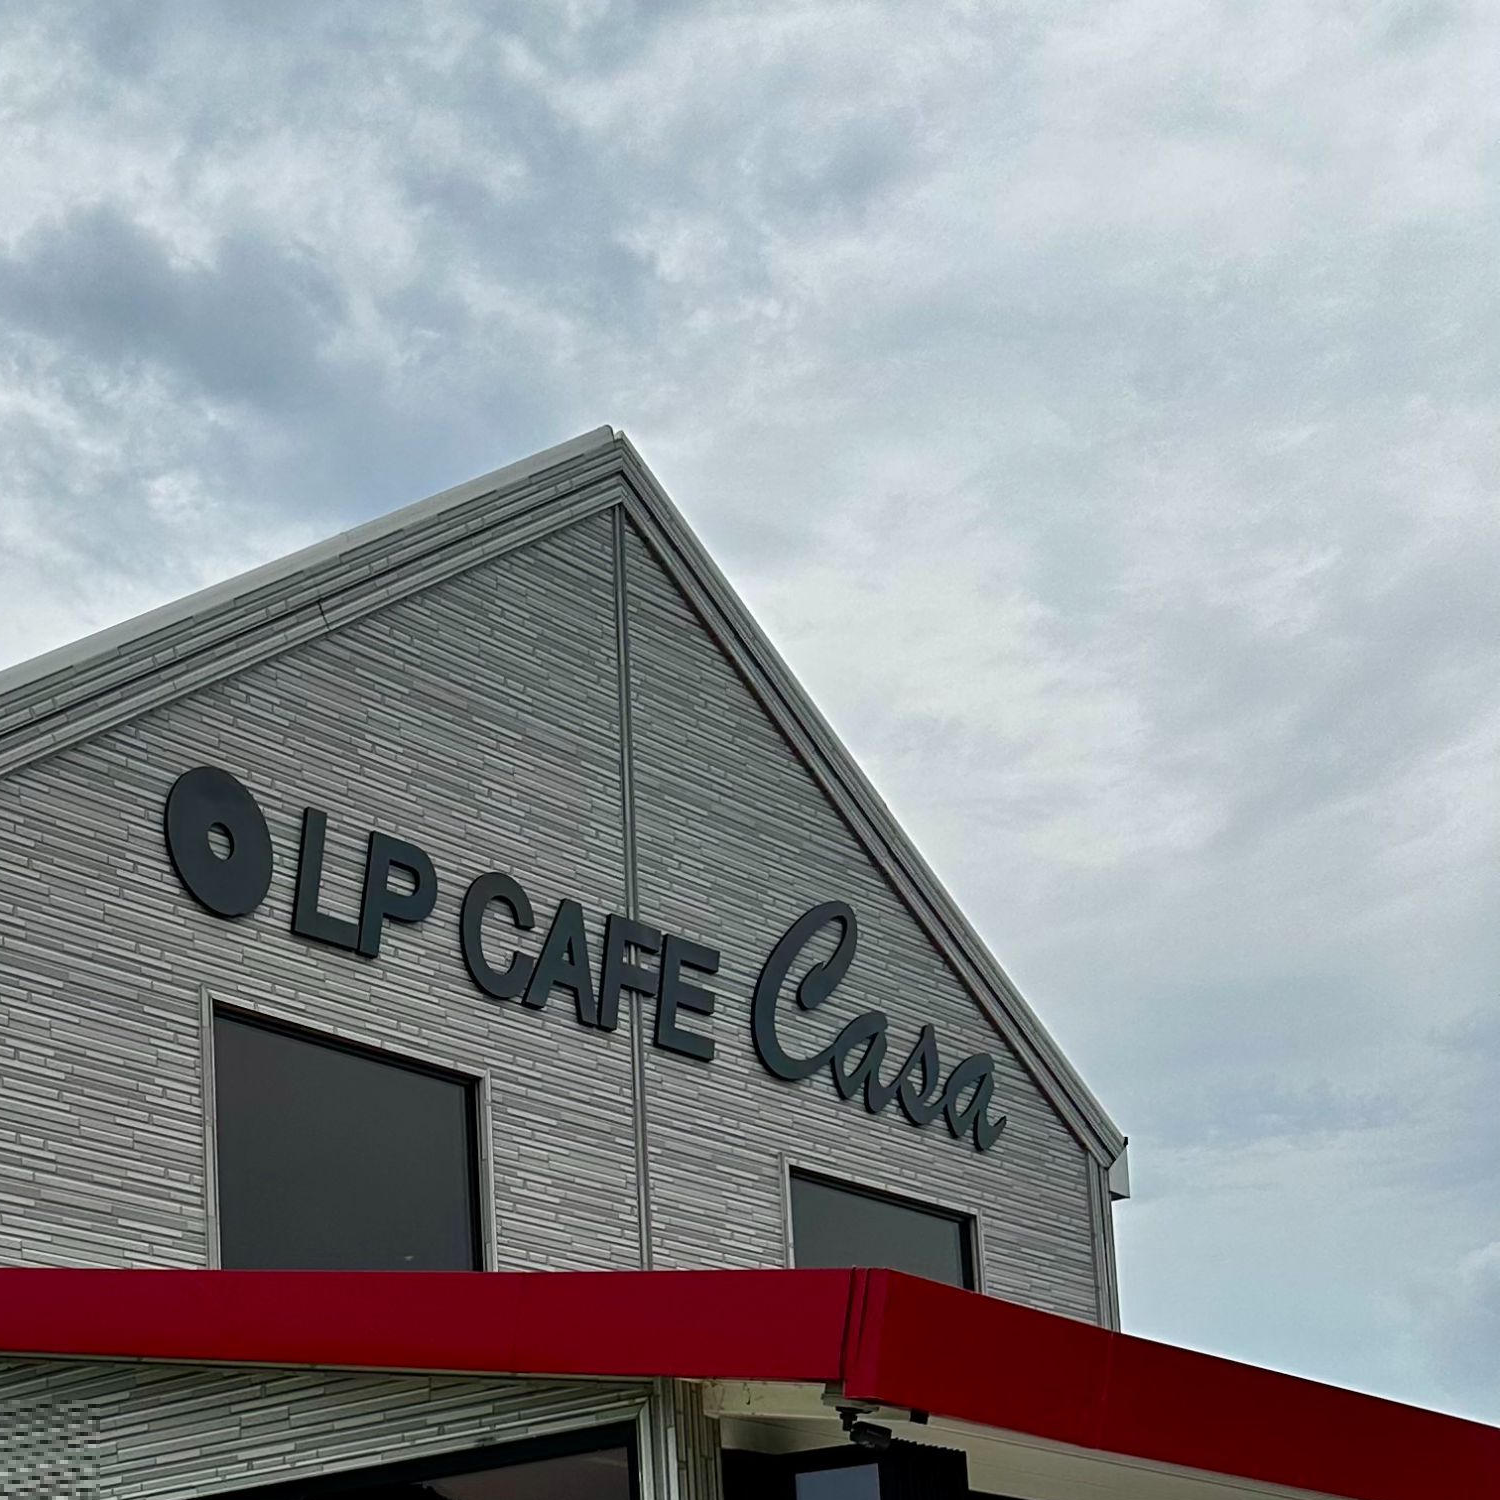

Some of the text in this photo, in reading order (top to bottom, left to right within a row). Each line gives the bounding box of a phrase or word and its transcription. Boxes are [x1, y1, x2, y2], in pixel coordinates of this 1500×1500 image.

[291, 807, 1008, 1152] LP CAFE Casa
